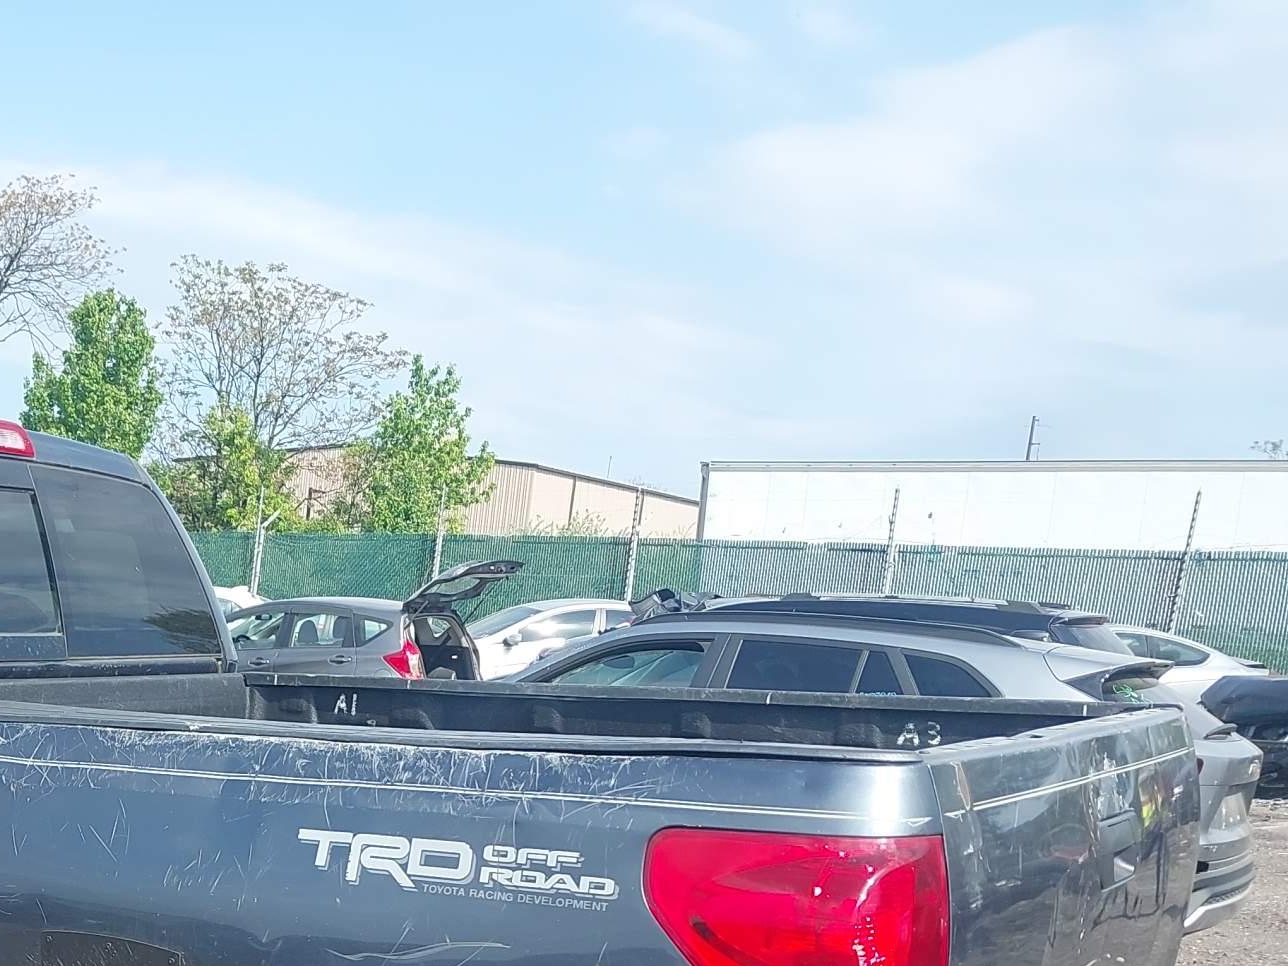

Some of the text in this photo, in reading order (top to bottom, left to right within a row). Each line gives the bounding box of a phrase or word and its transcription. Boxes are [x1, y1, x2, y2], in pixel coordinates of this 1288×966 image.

[298, 828, 477, 892] TRD
[483, 844, 584, 872] OFF
[422, 883, 609, 912] TOYOTA RACING DEVELOPMENT
[479, 866, 620, 900] ROAD
